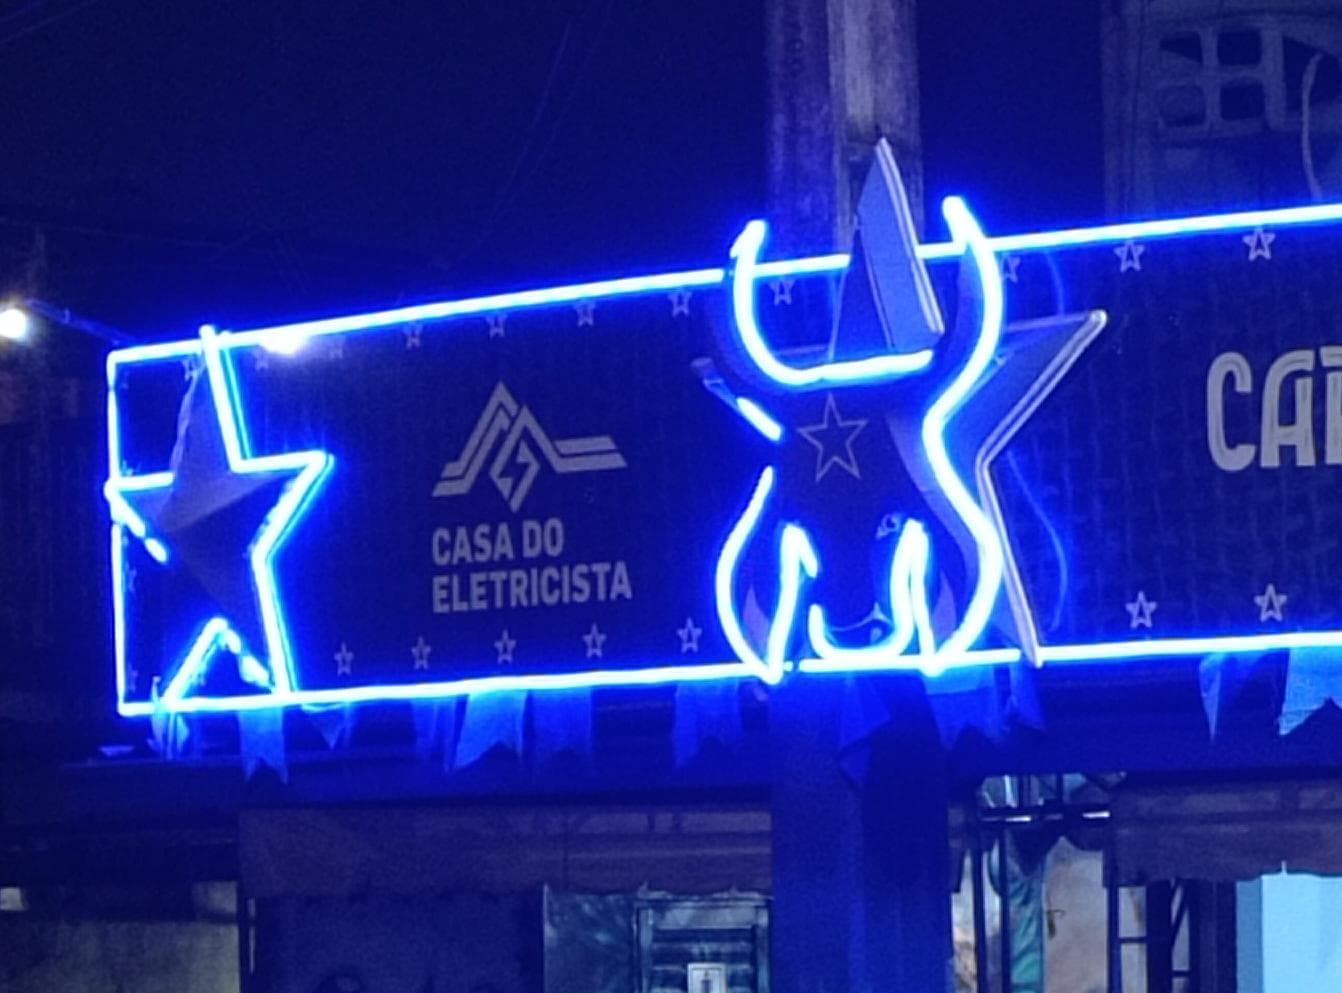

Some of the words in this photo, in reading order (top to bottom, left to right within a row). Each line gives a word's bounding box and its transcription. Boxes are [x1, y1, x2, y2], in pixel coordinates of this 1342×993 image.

[432, 522, 515, 566] CASA
[522, 517, 565, 558] DO
[432, 559, 633, 614] ELETRICISTA
